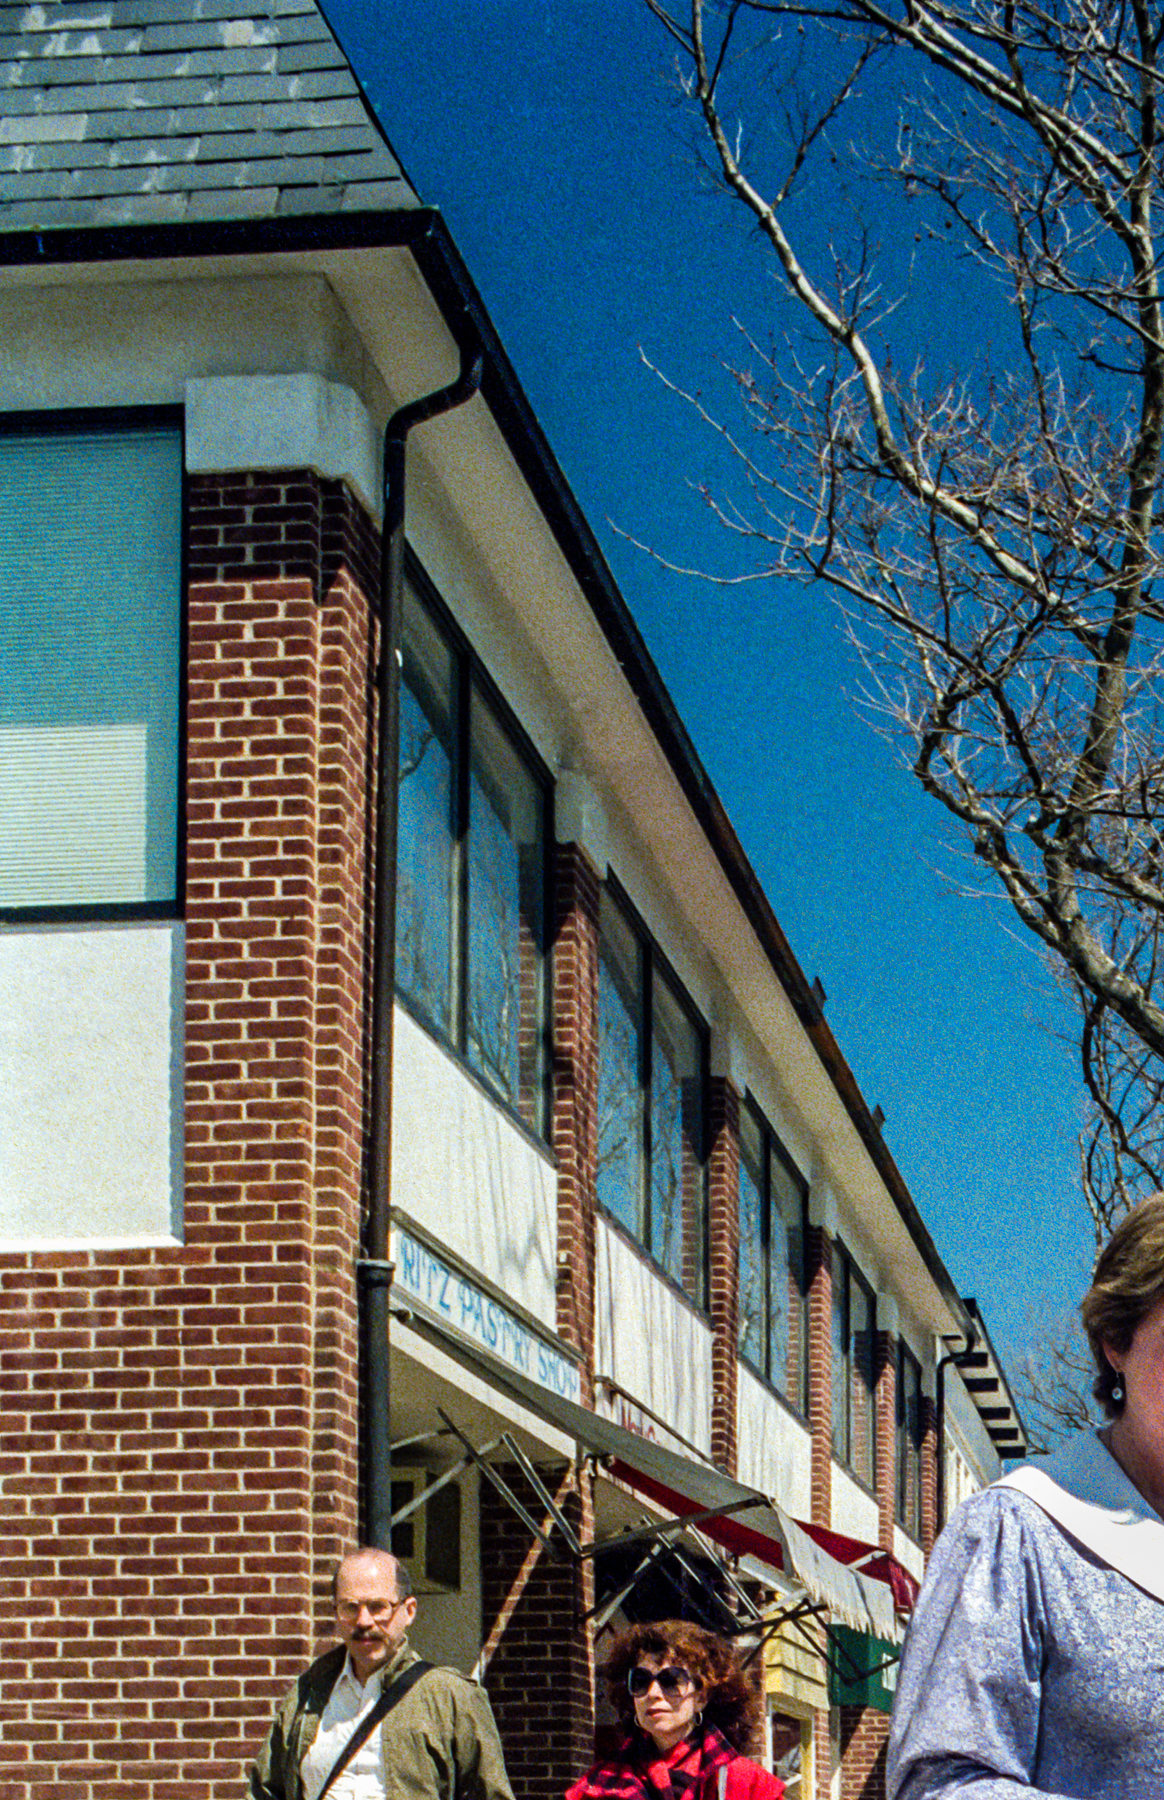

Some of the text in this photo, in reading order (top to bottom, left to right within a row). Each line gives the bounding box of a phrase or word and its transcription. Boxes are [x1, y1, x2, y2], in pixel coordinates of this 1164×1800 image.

[401, 1234, 577, 1400] RITZ PASTRY SHOP
